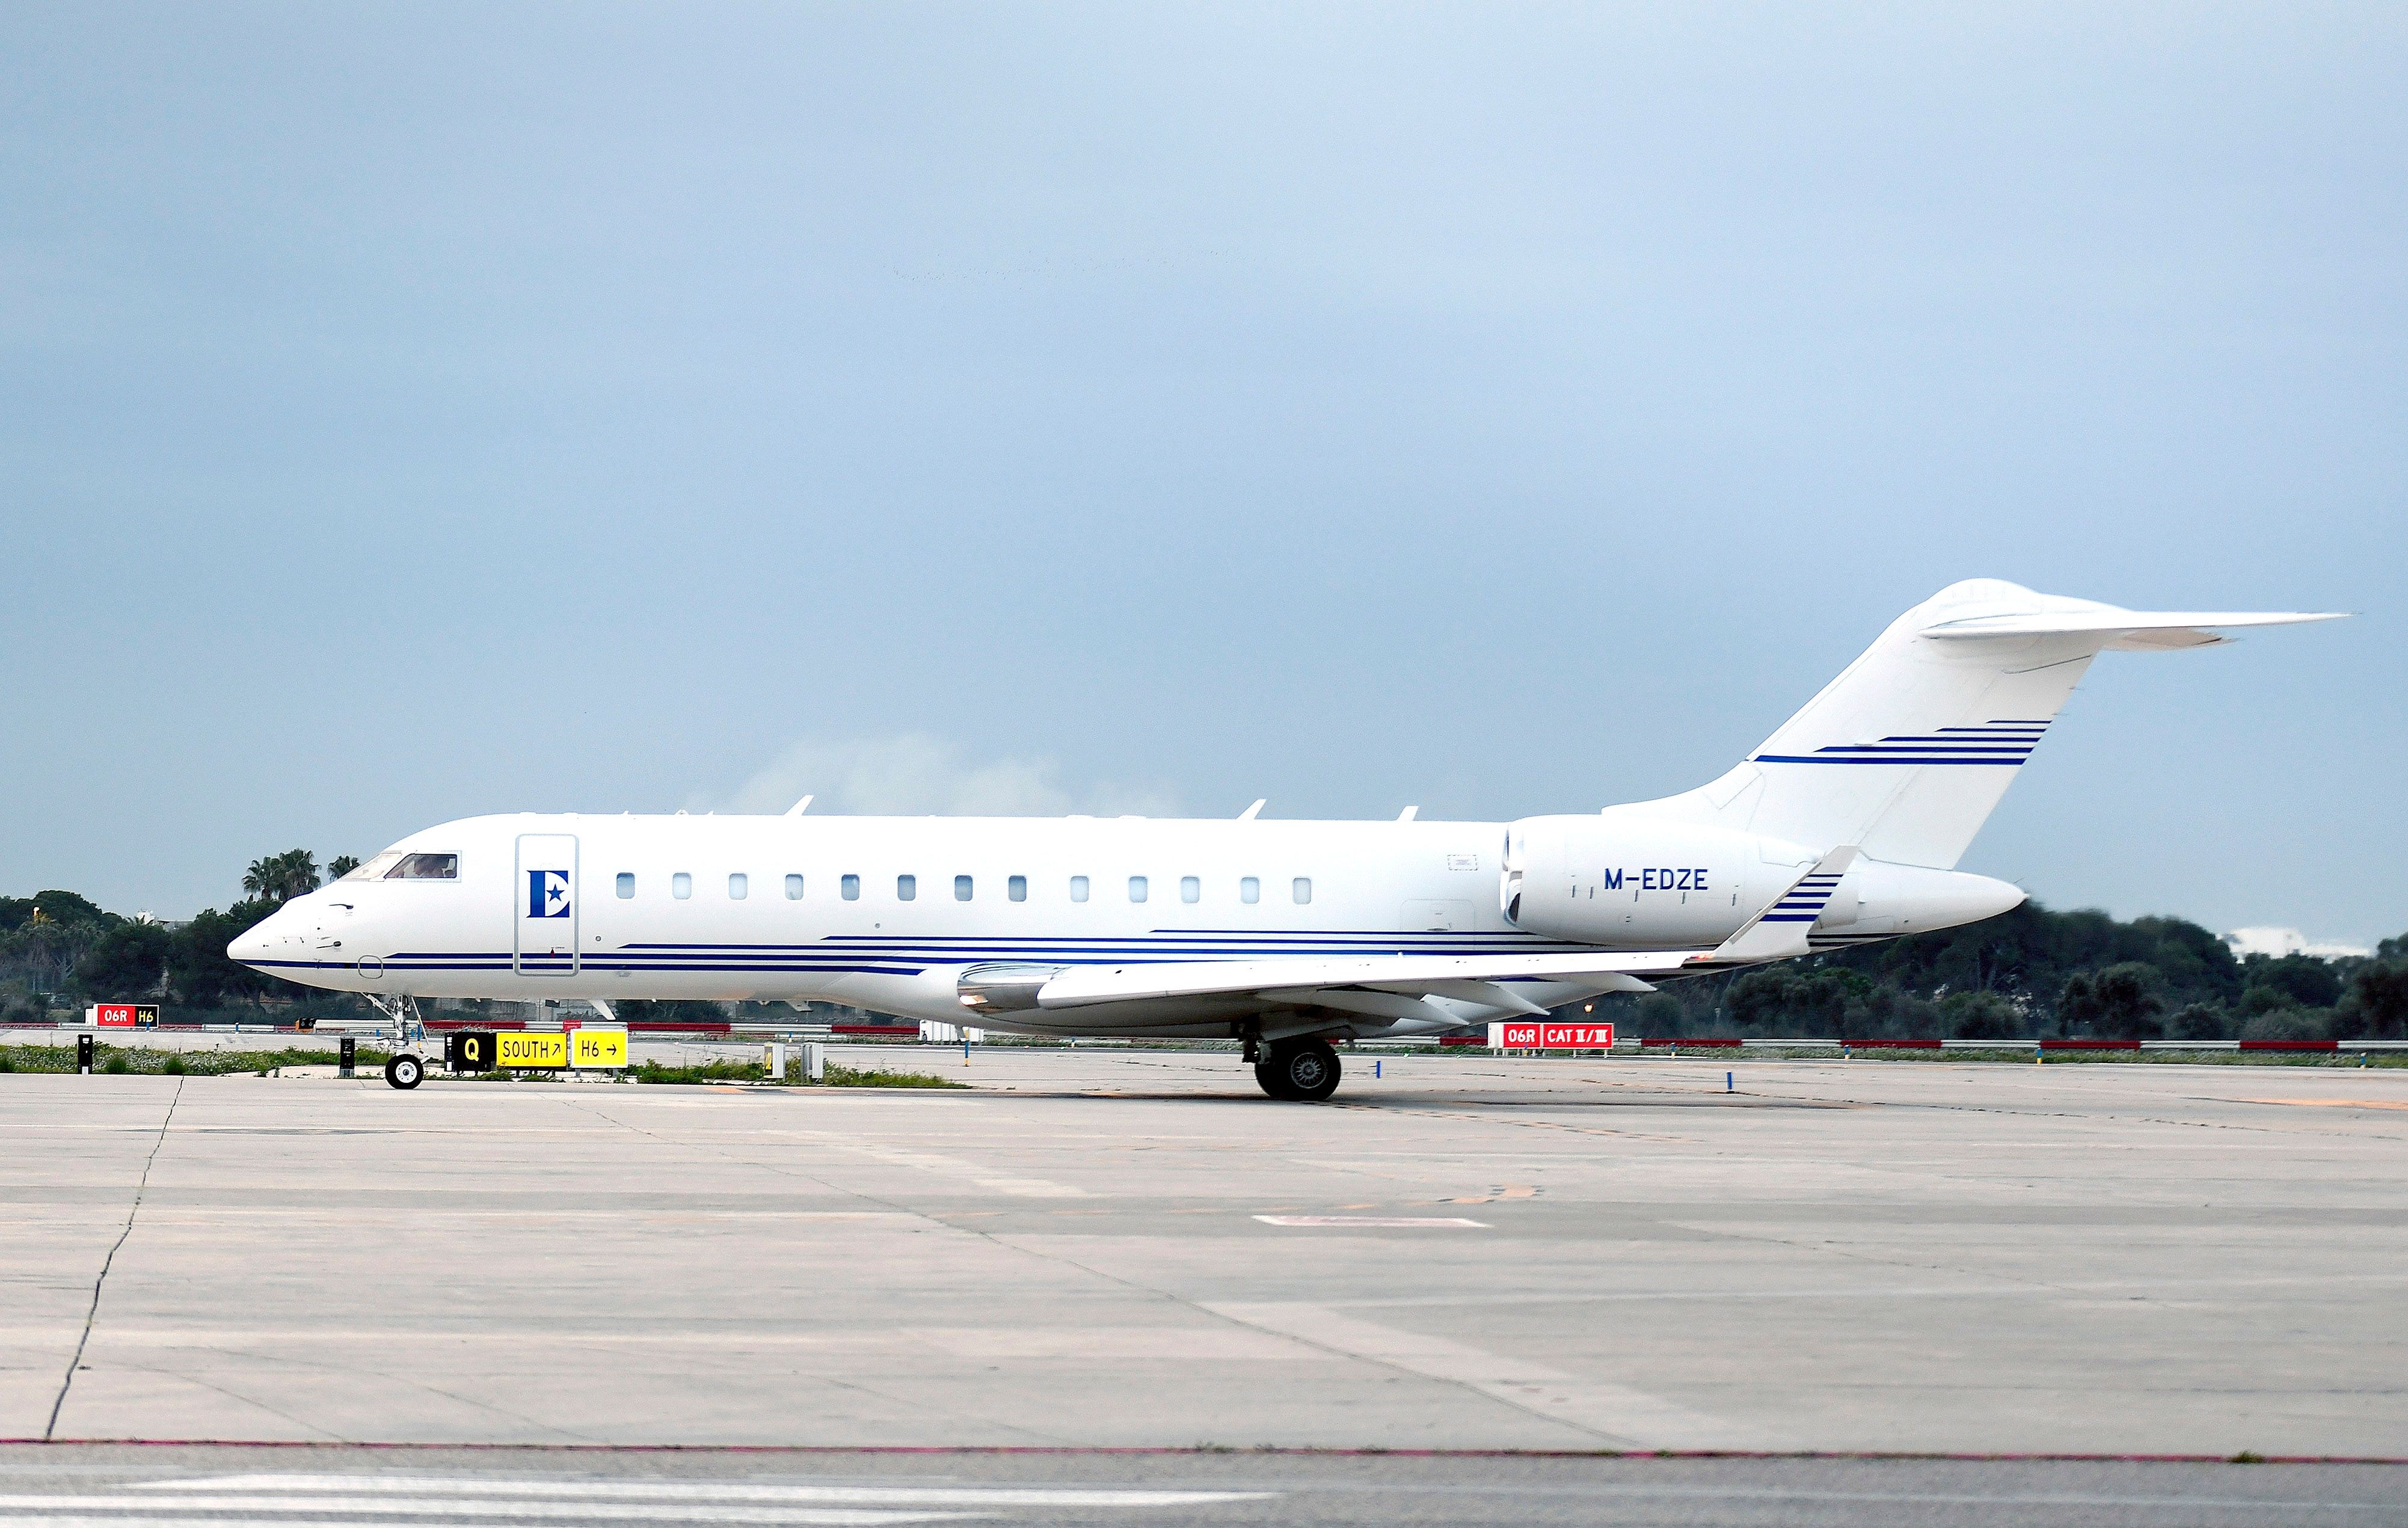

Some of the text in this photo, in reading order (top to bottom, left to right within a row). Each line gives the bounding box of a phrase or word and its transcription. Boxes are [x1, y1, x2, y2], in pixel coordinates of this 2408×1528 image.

[1604, 868, 1709, 890] M-EDZE
[526, 870, 570, 918] E
[104, 1009, 153, 1023] 06R H6
[1508, 1029, 1608, 1043] 06R CAT II/III
[464, 1038, 480, 1062] Q
[503, 1041, 548, 1058] SOUTH
[582, 1040, 599, 1057] H6
